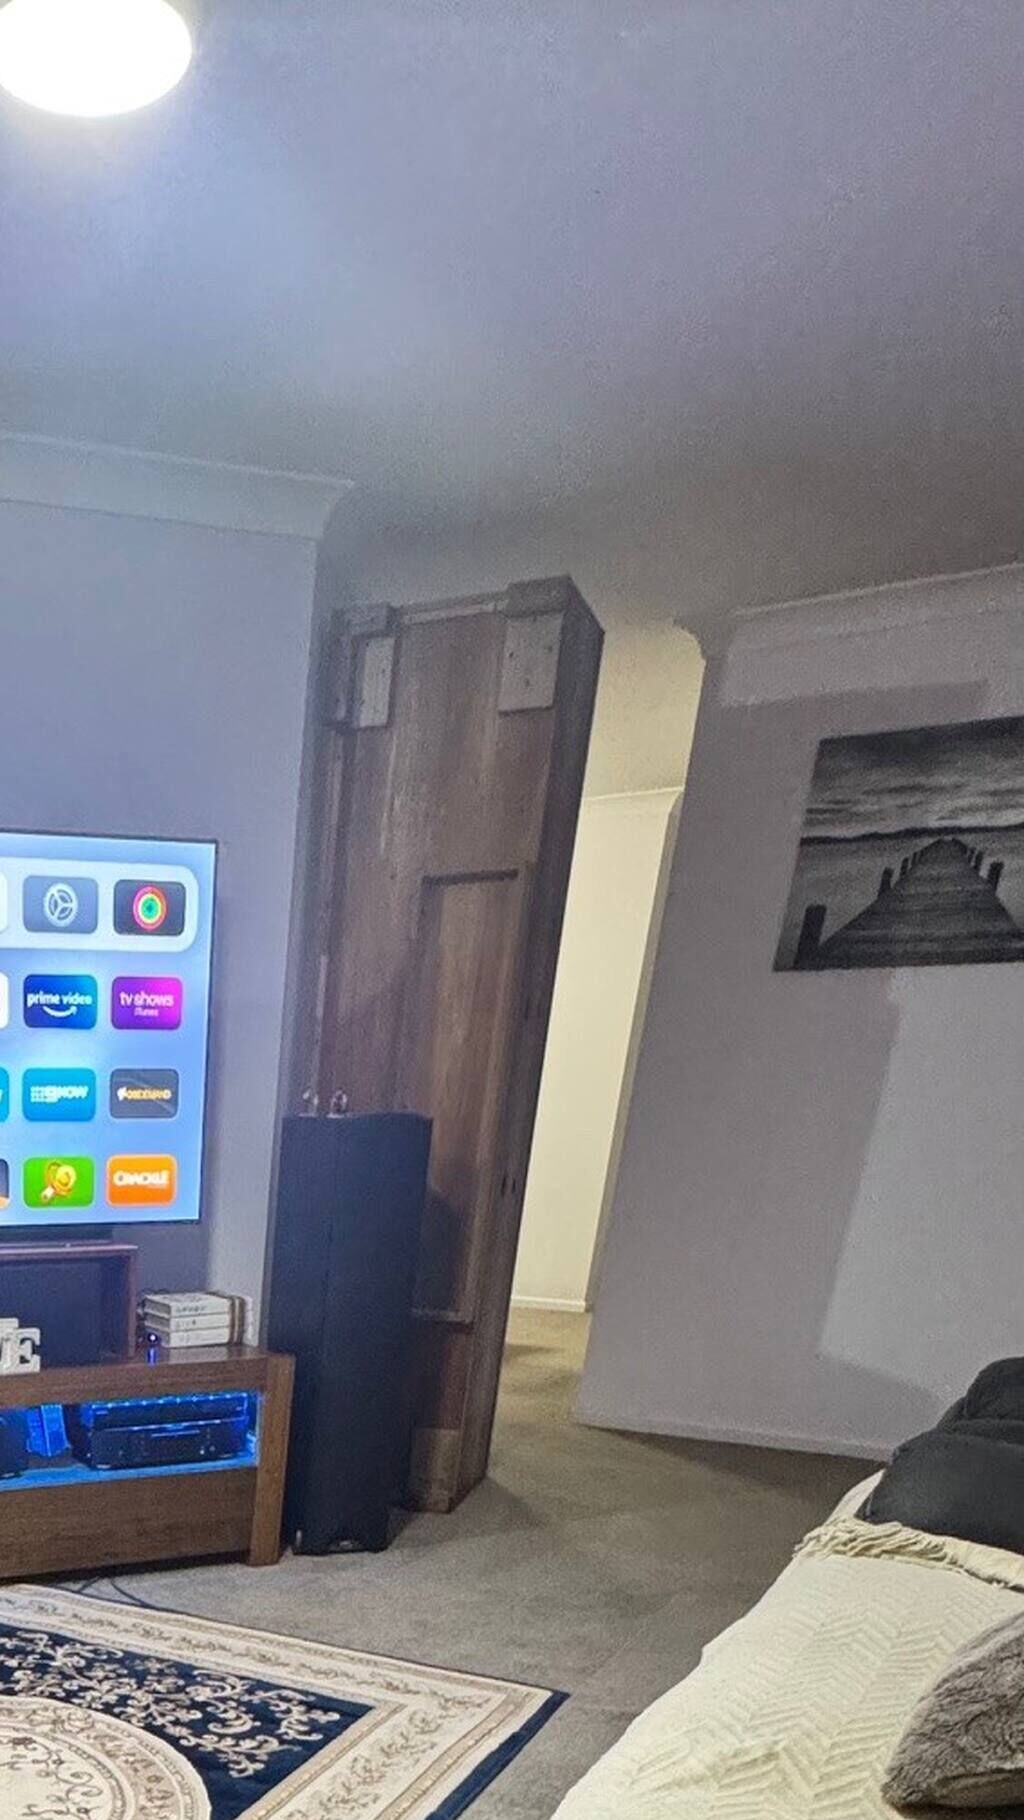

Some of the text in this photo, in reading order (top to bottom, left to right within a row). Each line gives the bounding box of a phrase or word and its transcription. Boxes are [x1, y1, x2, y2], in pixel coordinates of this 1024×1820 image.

[27, 991, 93, 1008] prime video
[134, 992, 174, 1007] shows
